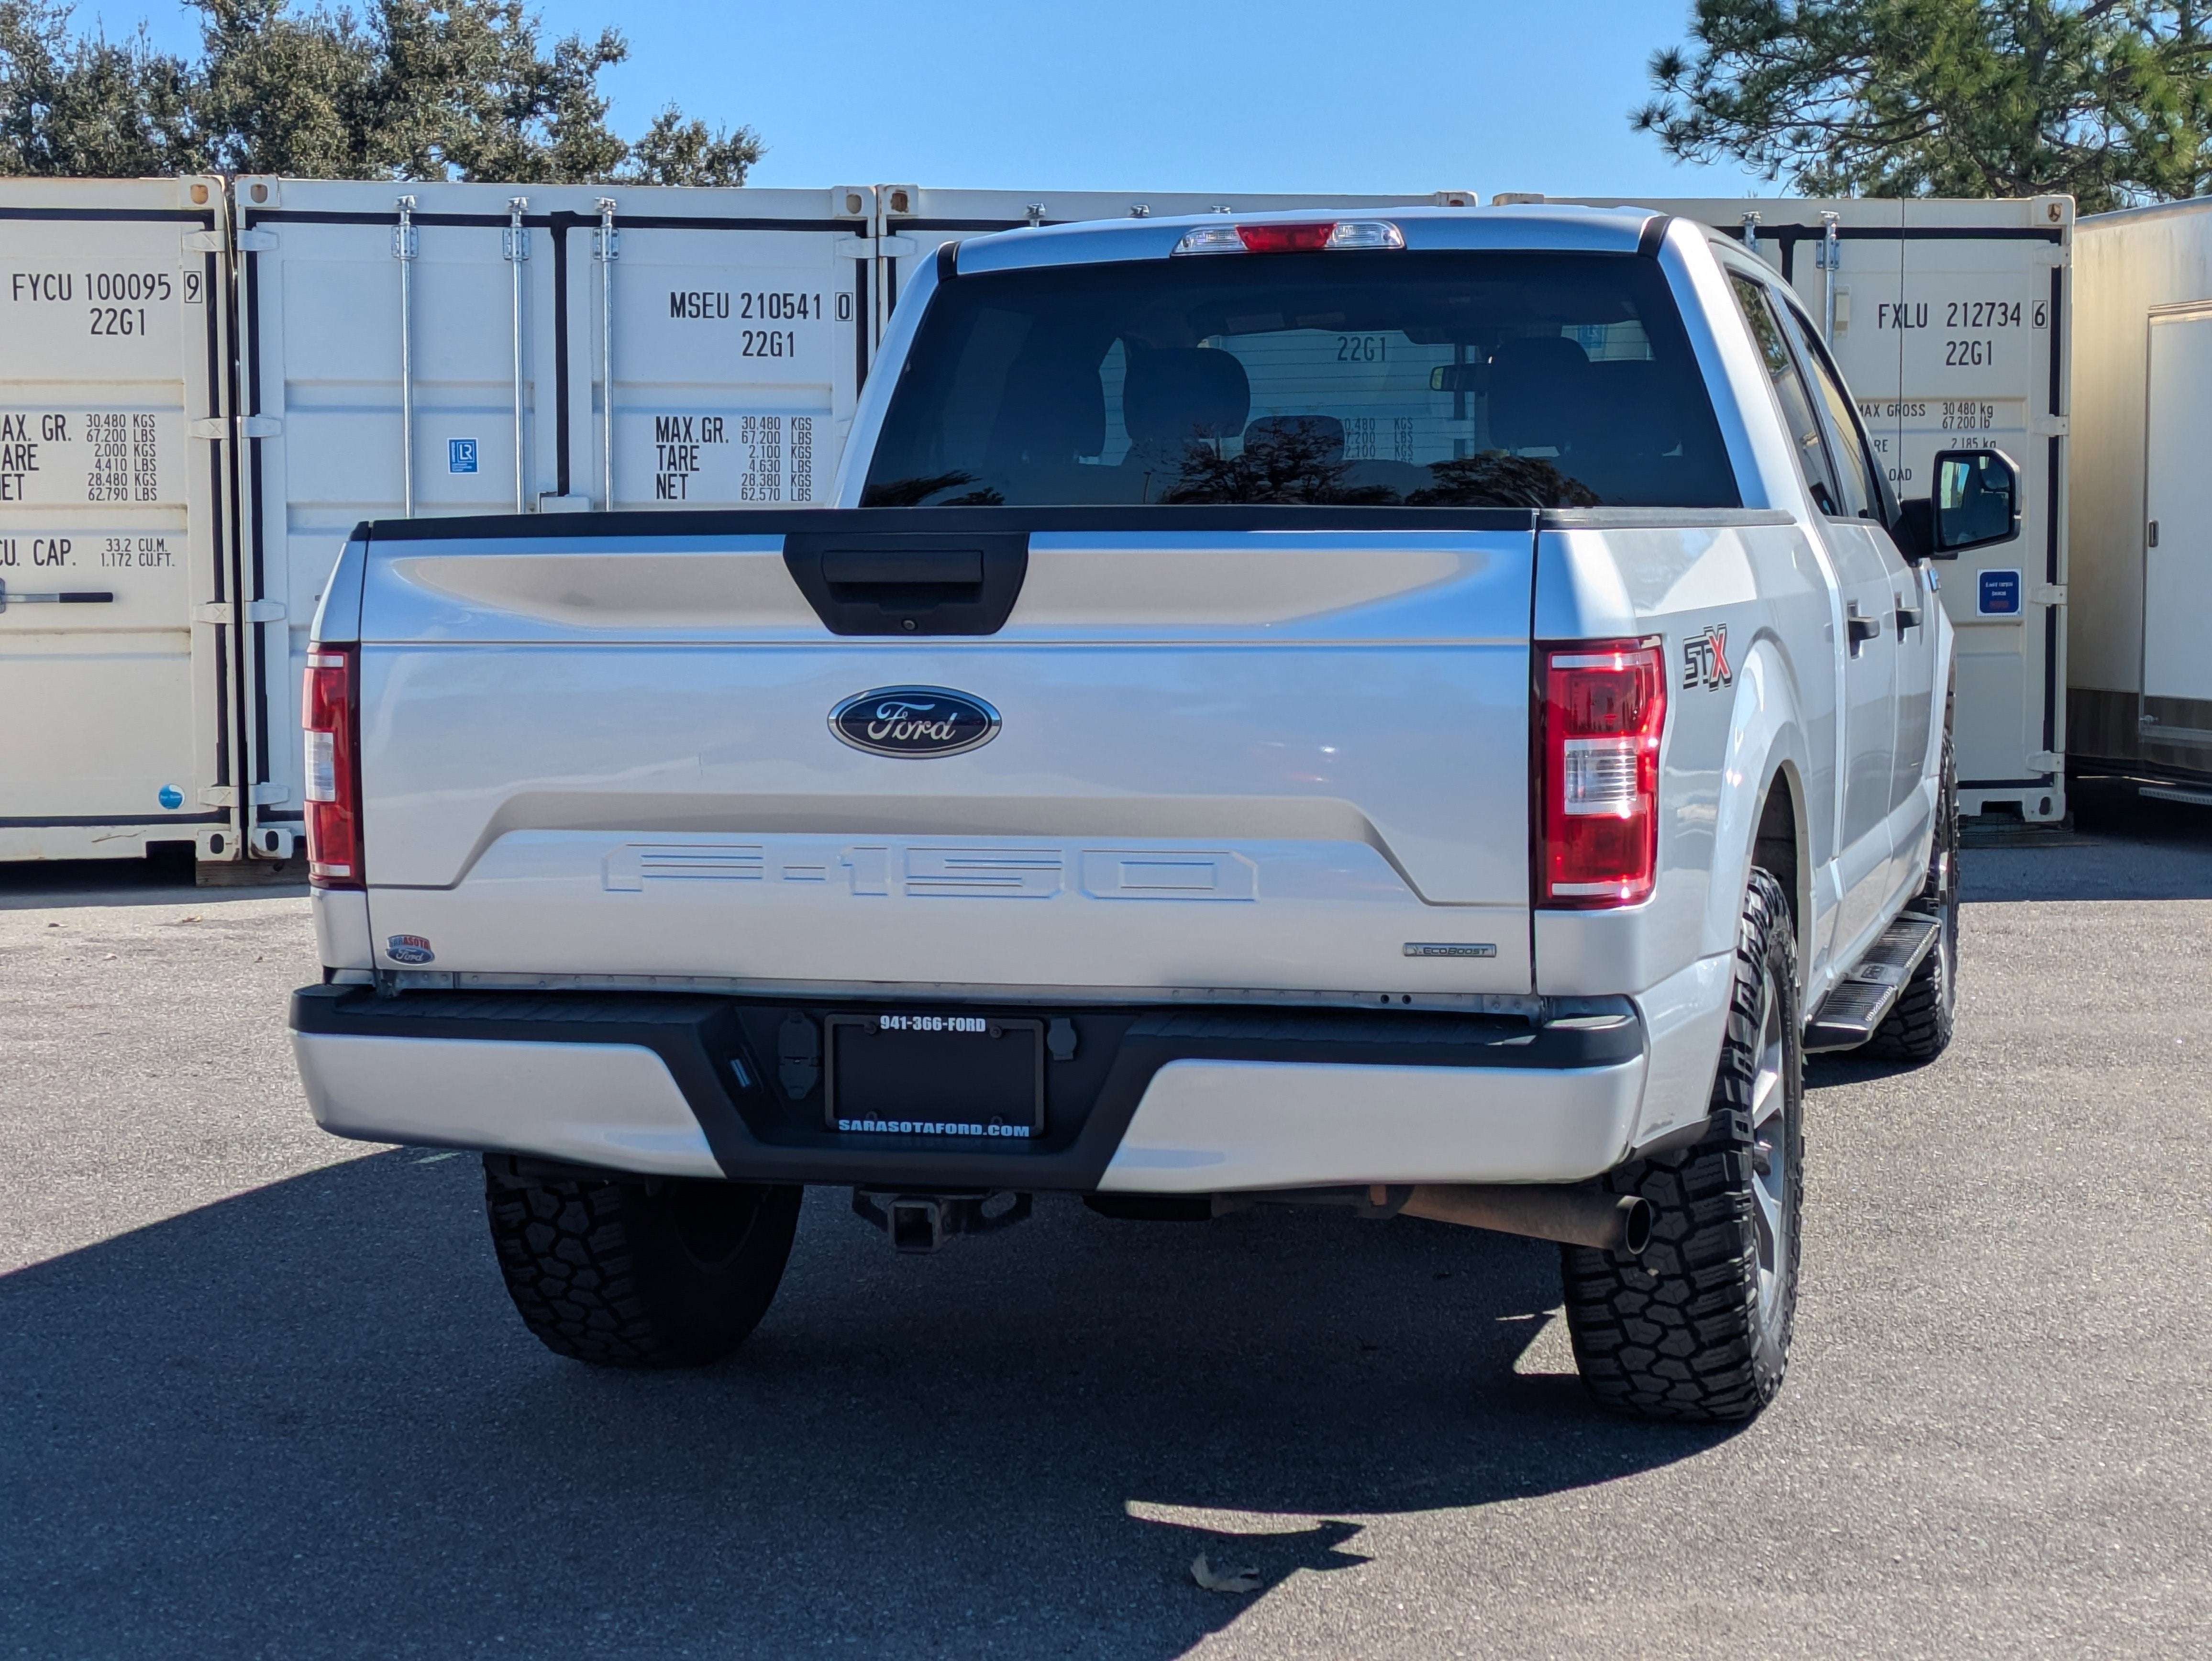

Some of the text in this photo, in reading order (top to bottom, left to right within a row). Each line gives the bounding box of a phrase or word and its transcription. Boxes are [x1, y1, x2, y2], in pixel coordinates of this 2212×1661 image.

[12, 273, 200, 301] FYCU 100095 9
[670, 292, 729, 319] MSEU
[741, 292, 820, 320] 210541
[1878, 302, 2046, 329] FXLU 212734 6
[90, 308, 145, 336] 22G1
[742, 331, 794, 357] 22G1
[1338, 336, 1385, 361] 22G1
[1946, 341, 1992, 365] 22G1
[1887, 404, 1926, 417] GROSS
[1980, 402, 1993, 419] kg
[0, 414, 32, 442] AX.
[42, 414, 71, 442] GR.
[133, 414, 155, 428] KGS
[791, 417, 812, 431] KGS
[1394, 417, 1413, 431] KGS
[1980, 415, 1991, 429] lb
[133, 429, 155, 443] LBS
[791, 431, 812, 445] LBS
[1394, 431, 1413, 444] LBS
[1, 444, 39, 471] ARE
[134, 443, 156, 457] KGS
[459, 444, 473, 460] LR
[656, 445, 700, 471] TARE
[791, 445, 812, 459] KGS
[1394, 444, 1414, 458] KGS
[134, 458, 156, 472] LBS
[791, 460, 812, 474] LBS
[0, 474, 24, 500] ET
[134, 473, 157, 487] KGS
[135, 487, 157, 501] LBS
[656, 474, 688, 500] NET
[791, 474, 812, 487] KGS
[791, 488, 811, 501] LBS
[0, 539, 20, 566] U.
[33, 539, 76, 566] CAP.
[106, 538, 132, 552] 33.2
[1683, 622, 1732, 693] STX
[867, 701, 958, 740] Ford
[600, 843, 1259, 903] F-150
[389, 936, 430, 951] SARASOTA
[395, 948, 424, 962] Ford
[879, 1015, 986, 1033] 941-366-FORD
[838, 1119, 1030, 1138] SARASOTAFORD.COM
